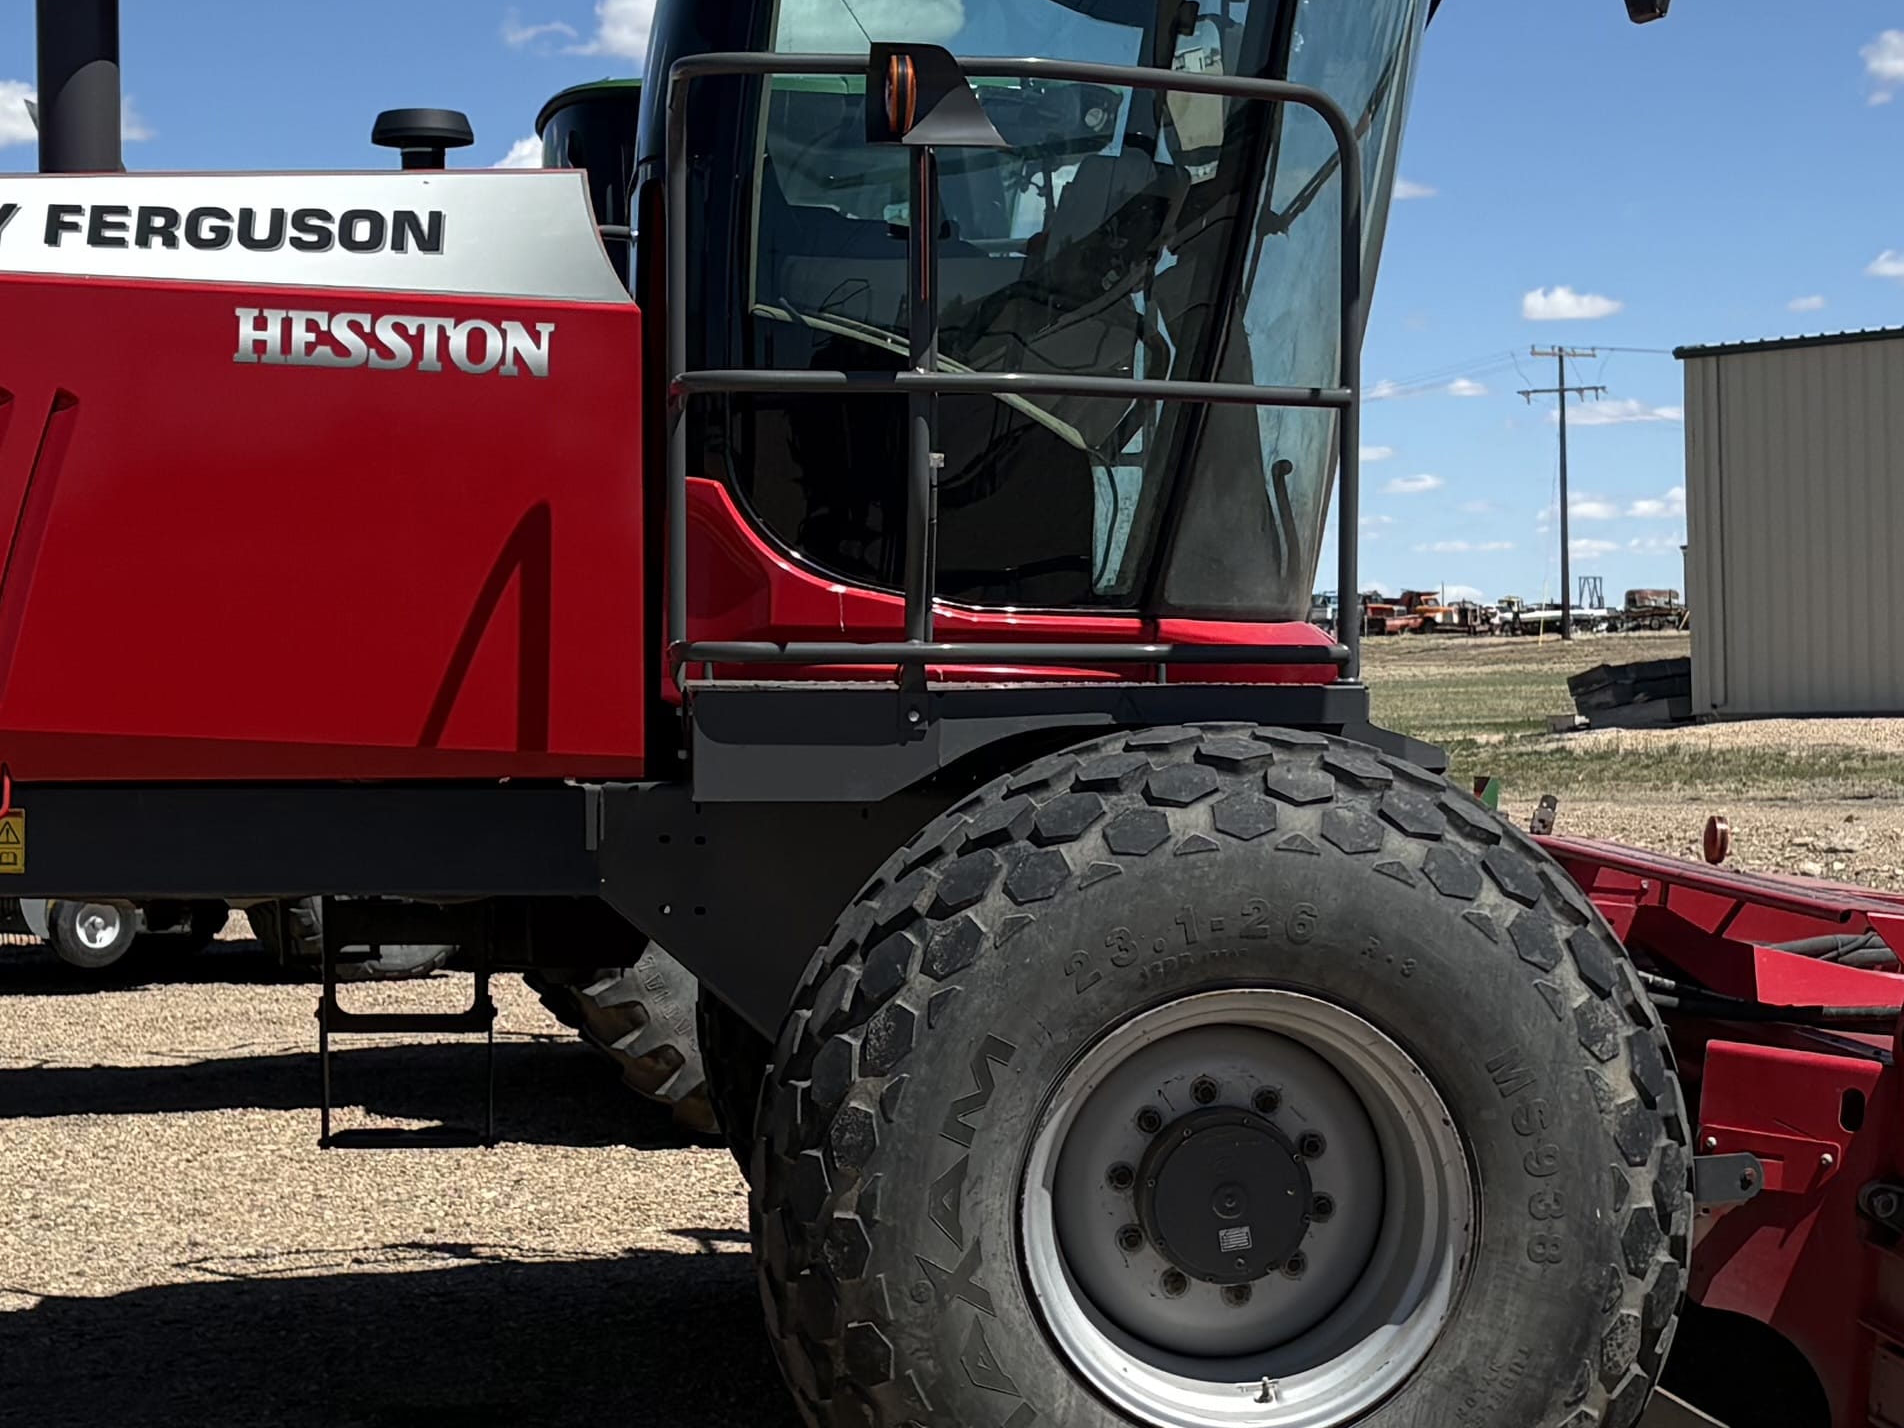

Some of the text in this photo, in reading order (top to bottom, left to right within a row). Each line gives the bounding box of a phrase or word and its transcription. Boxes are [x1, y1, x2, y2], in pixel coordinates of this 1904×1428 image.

[44, 203, 444, 254] FERGUSON
[232, 306, 556, 378] HESSTON
[1063, 896, 1321, 995] 23.1-26
[1484, 1043, 1567, 1267] MS938
